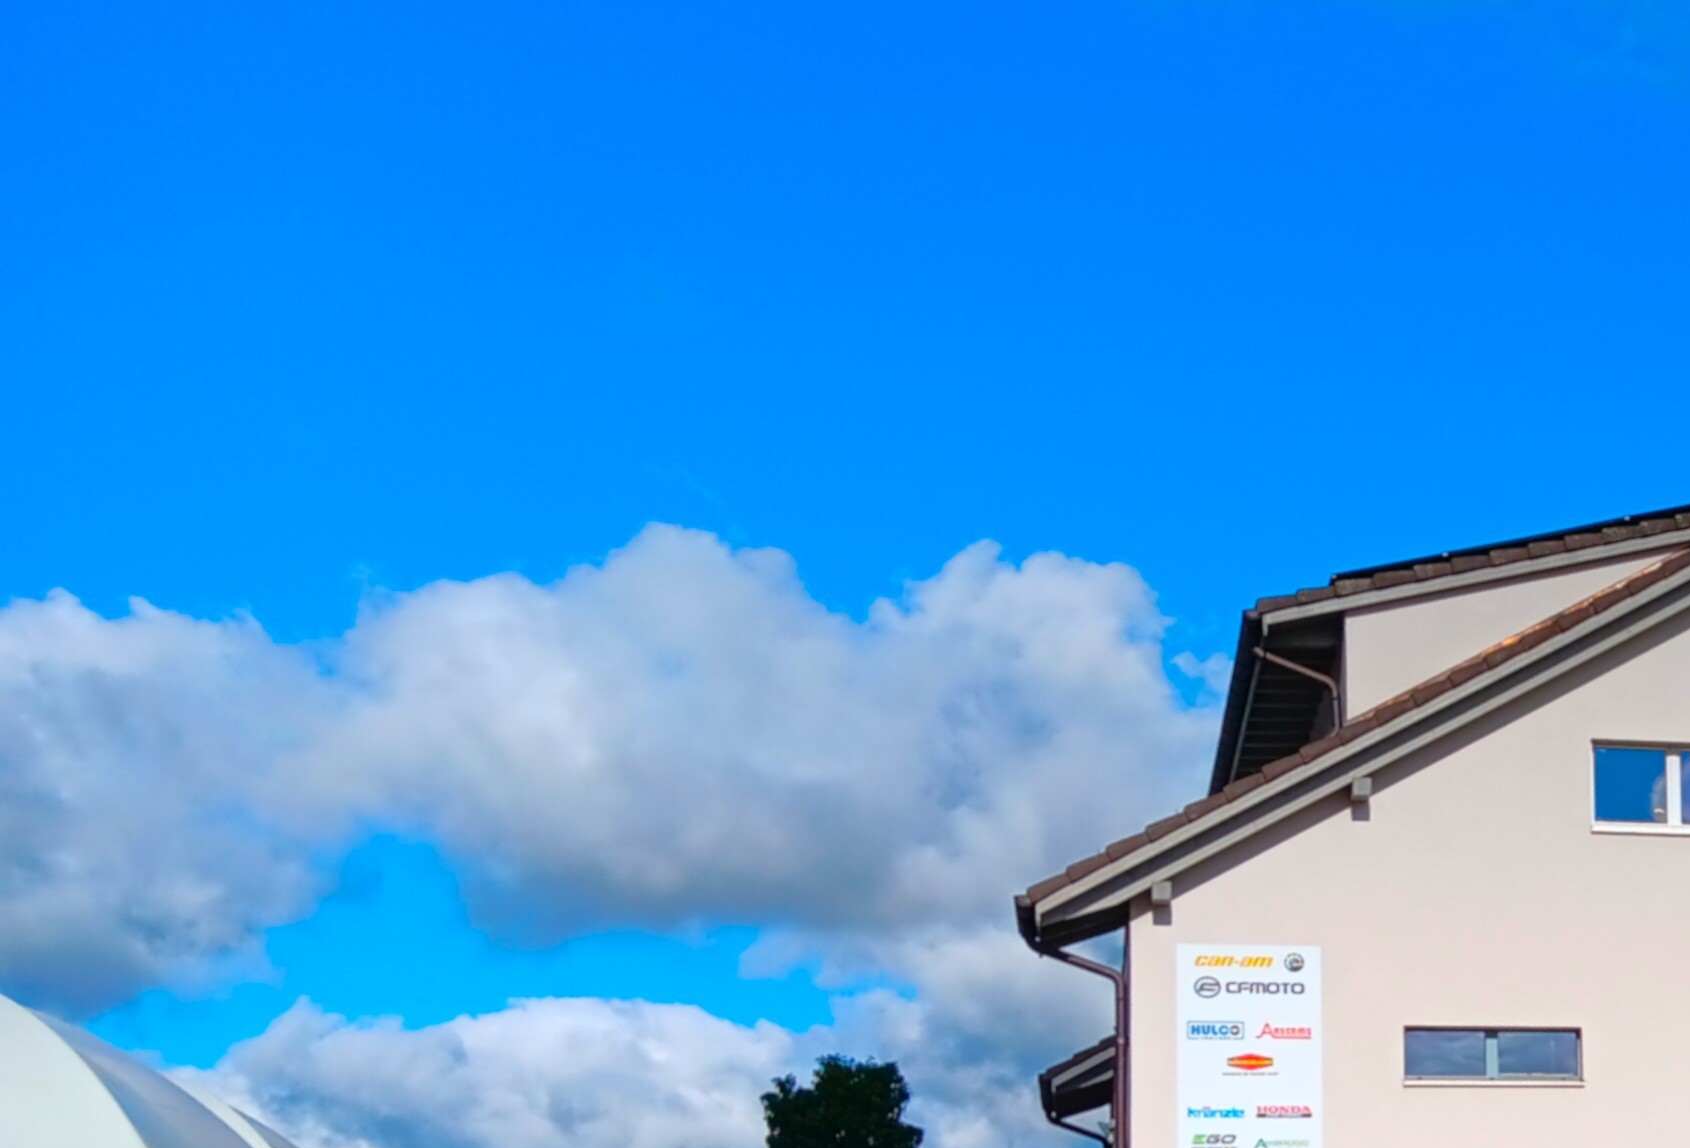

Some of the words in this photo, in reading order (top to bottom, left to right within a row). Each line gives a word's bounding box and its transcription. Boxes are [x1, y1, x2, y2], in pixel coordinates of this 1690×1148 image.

[1225, 981, 1305, 995] CFMOTO
[1190, 1025, 1241, 1036] HULCO
[1256, 1105, 1312, 1115] HONDA
[1192, 1134, 1237, 1144] EGO
